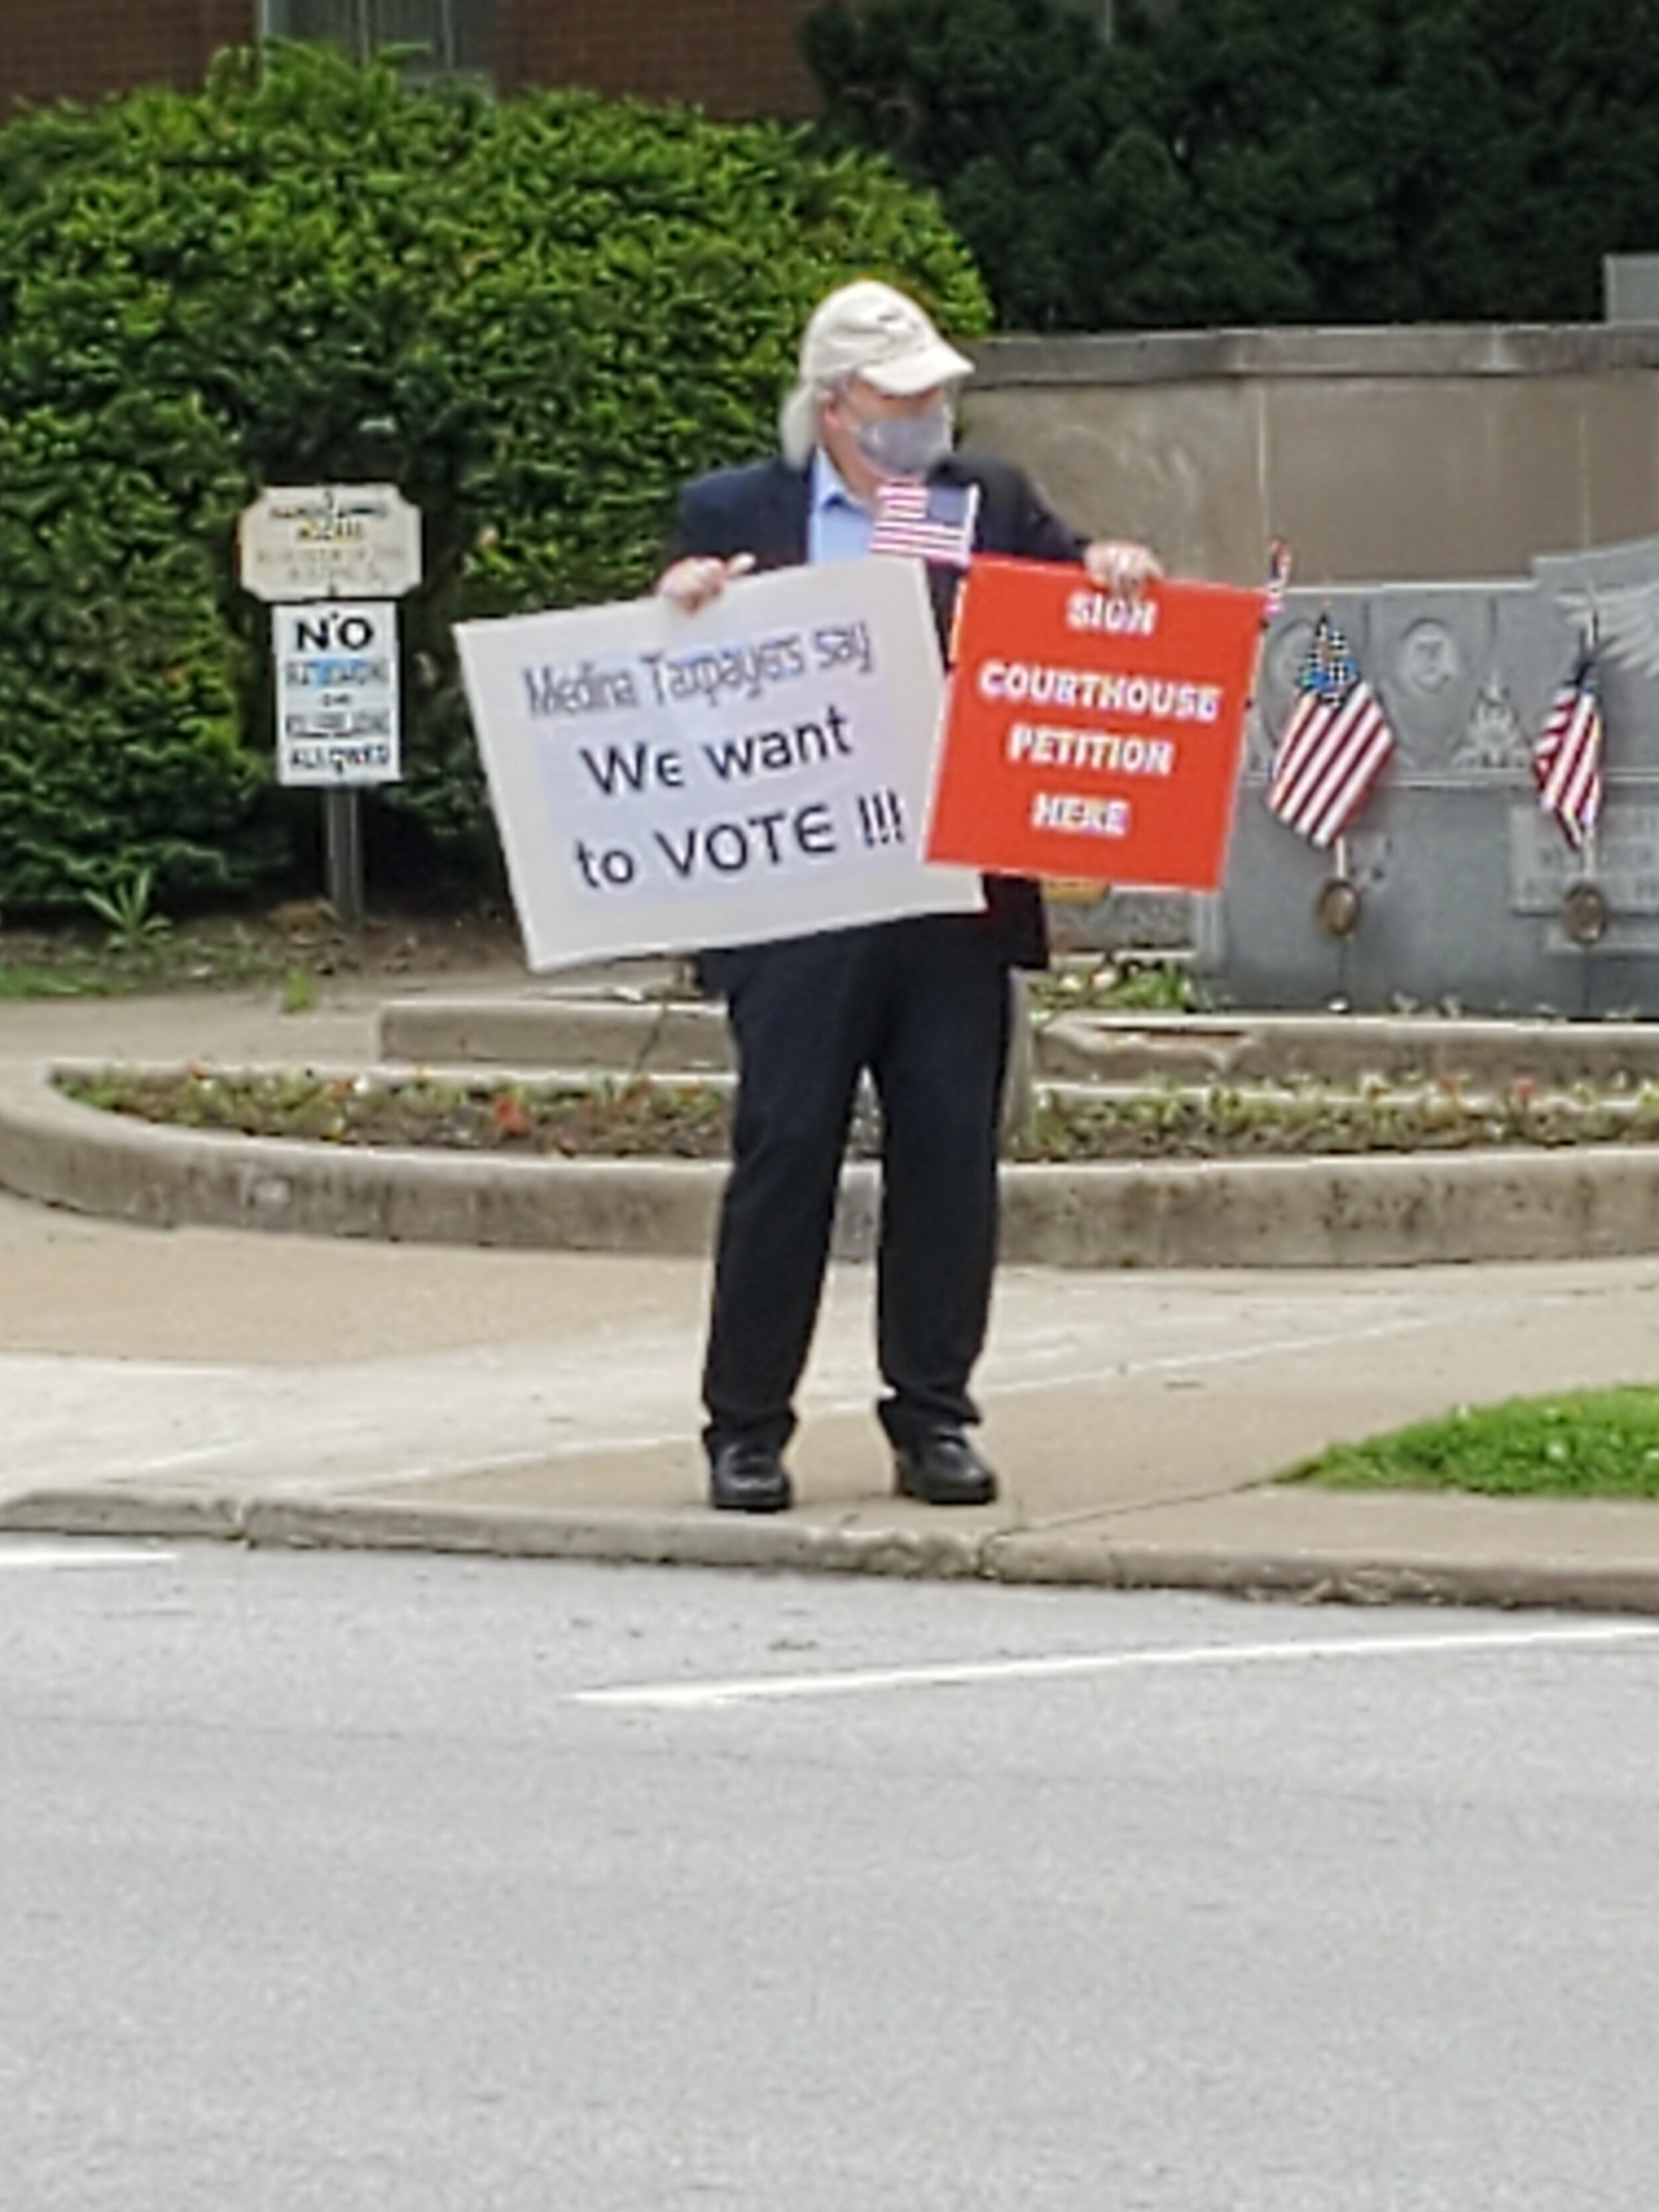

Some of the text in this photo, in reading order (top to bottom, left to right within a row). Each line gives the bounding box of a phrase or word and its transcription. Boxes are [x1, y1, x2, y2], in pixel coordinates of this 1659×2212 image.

[297, 617, 374, 651] NO
[1067, 590, 1157, 634] SIGN
[814, 619, 873, 674] say
[979, 661, 1222, 721] COURTHOUSE
[580, 704, 853, 796] We want
[1008, 723, 1174, 775] PETITION
[576, 790, 905, 888] to VOTE !!!
[1032, 793, 1128, 836] HERE
